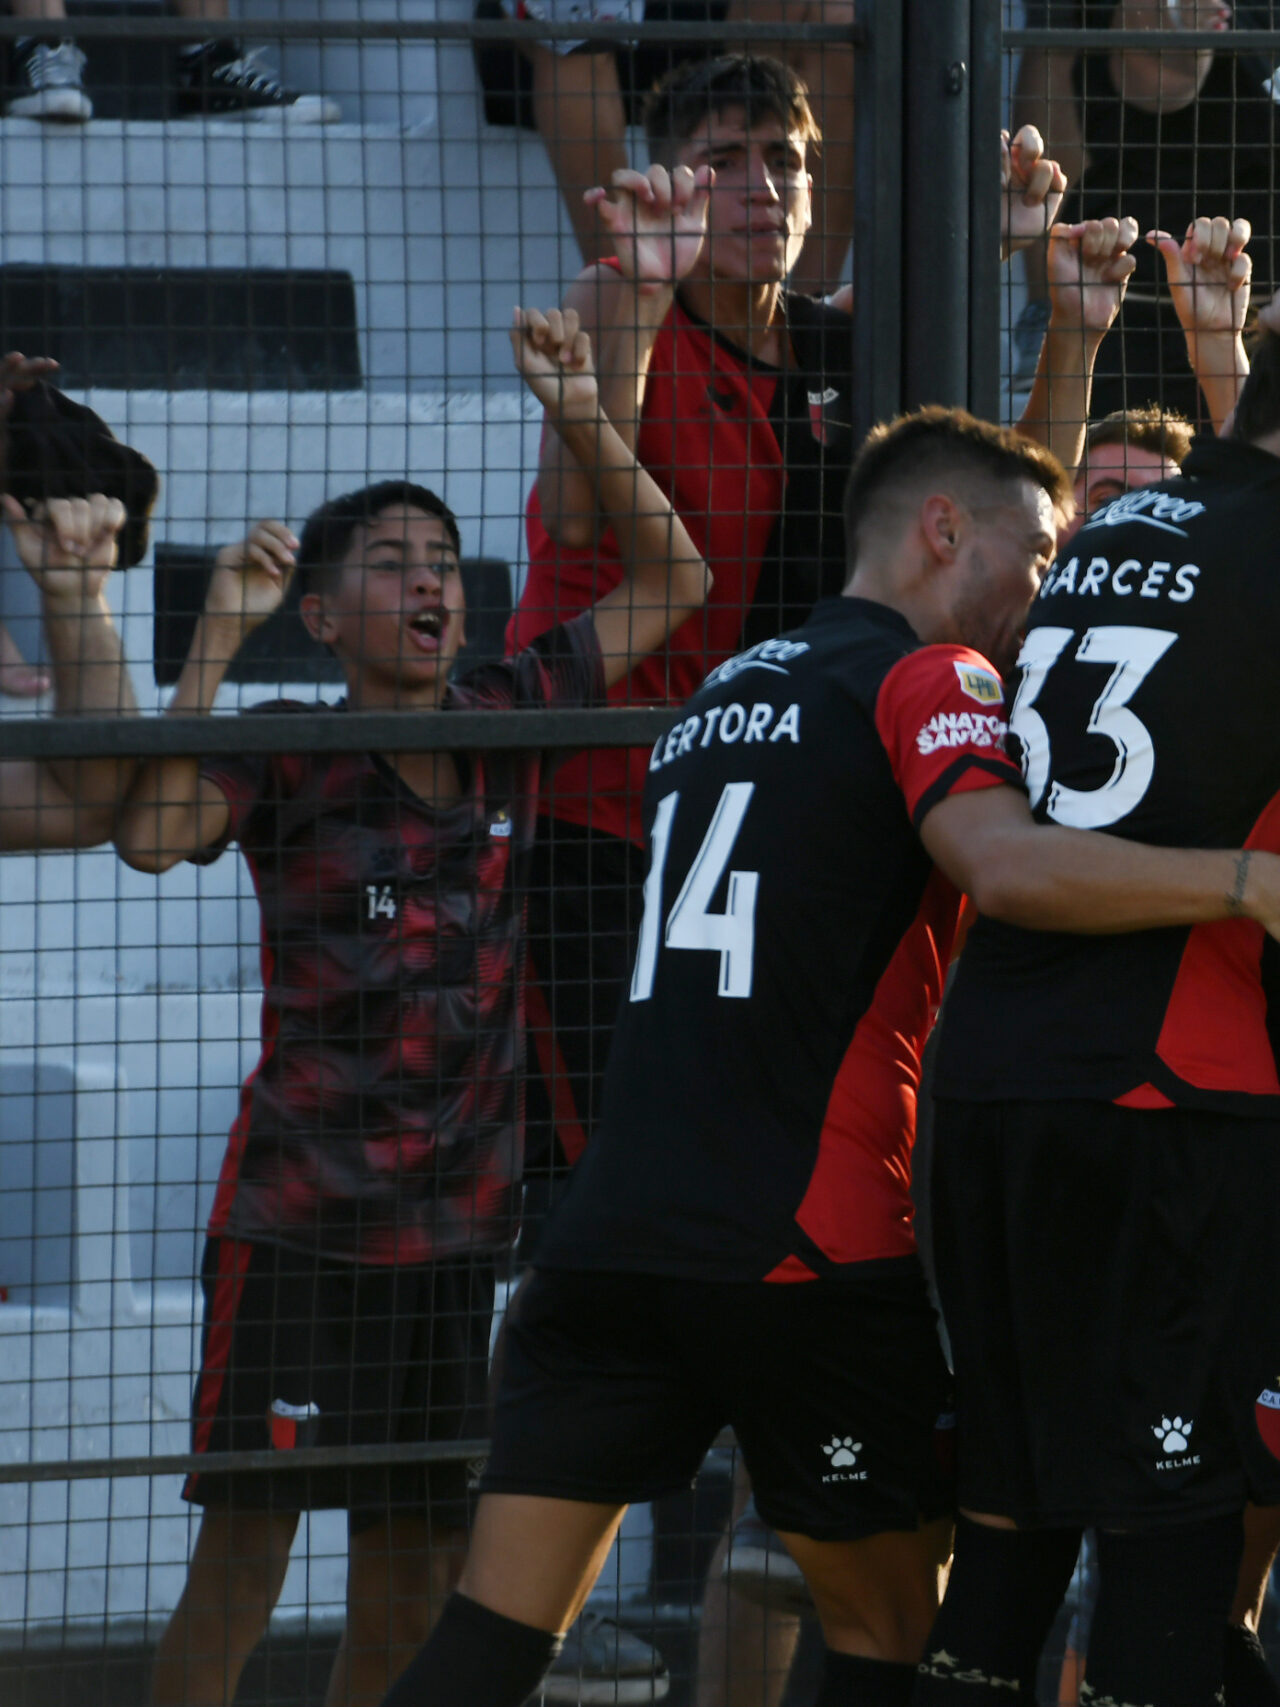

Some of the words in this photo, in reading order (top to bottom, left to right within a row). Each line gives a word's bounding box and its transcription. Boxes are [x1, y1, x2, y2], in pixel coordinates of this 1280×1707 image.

[649, 702, 800, 773] LERTORA
[1008, 625, 1179, 829] 33
[365, 884, 397, 920] 14
[630, 781, 760, 1003] 14
[821, 1470, 869, 1483] KELME
[1155, 1454, 1201, 1471] KELME
